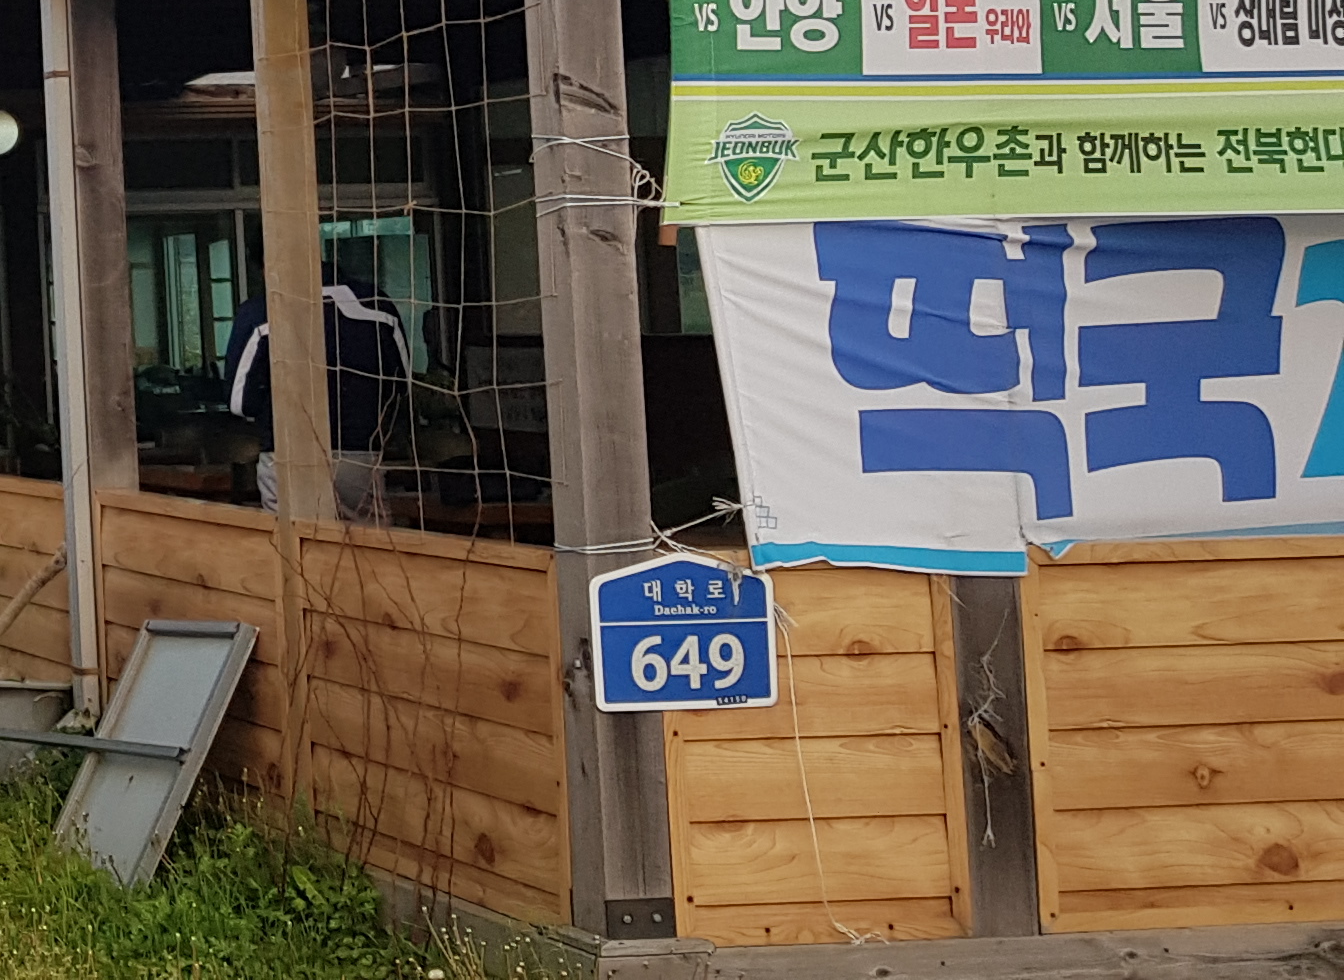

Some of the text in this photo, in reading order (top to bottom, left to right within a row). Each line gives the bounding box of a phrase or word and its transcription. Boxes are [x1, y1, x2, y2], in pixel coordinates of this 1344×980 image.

[985, 8, 1031, 45] 우라와
[709, 139, 800, 160] JEONBUK
[811, 125, 1066, 182] 군산한우촌과
[1077, 132, 1206, 174] 함께하는
[654, 605, 717, 616] Daehak-ro
[631, 633, 745, 692] 649
